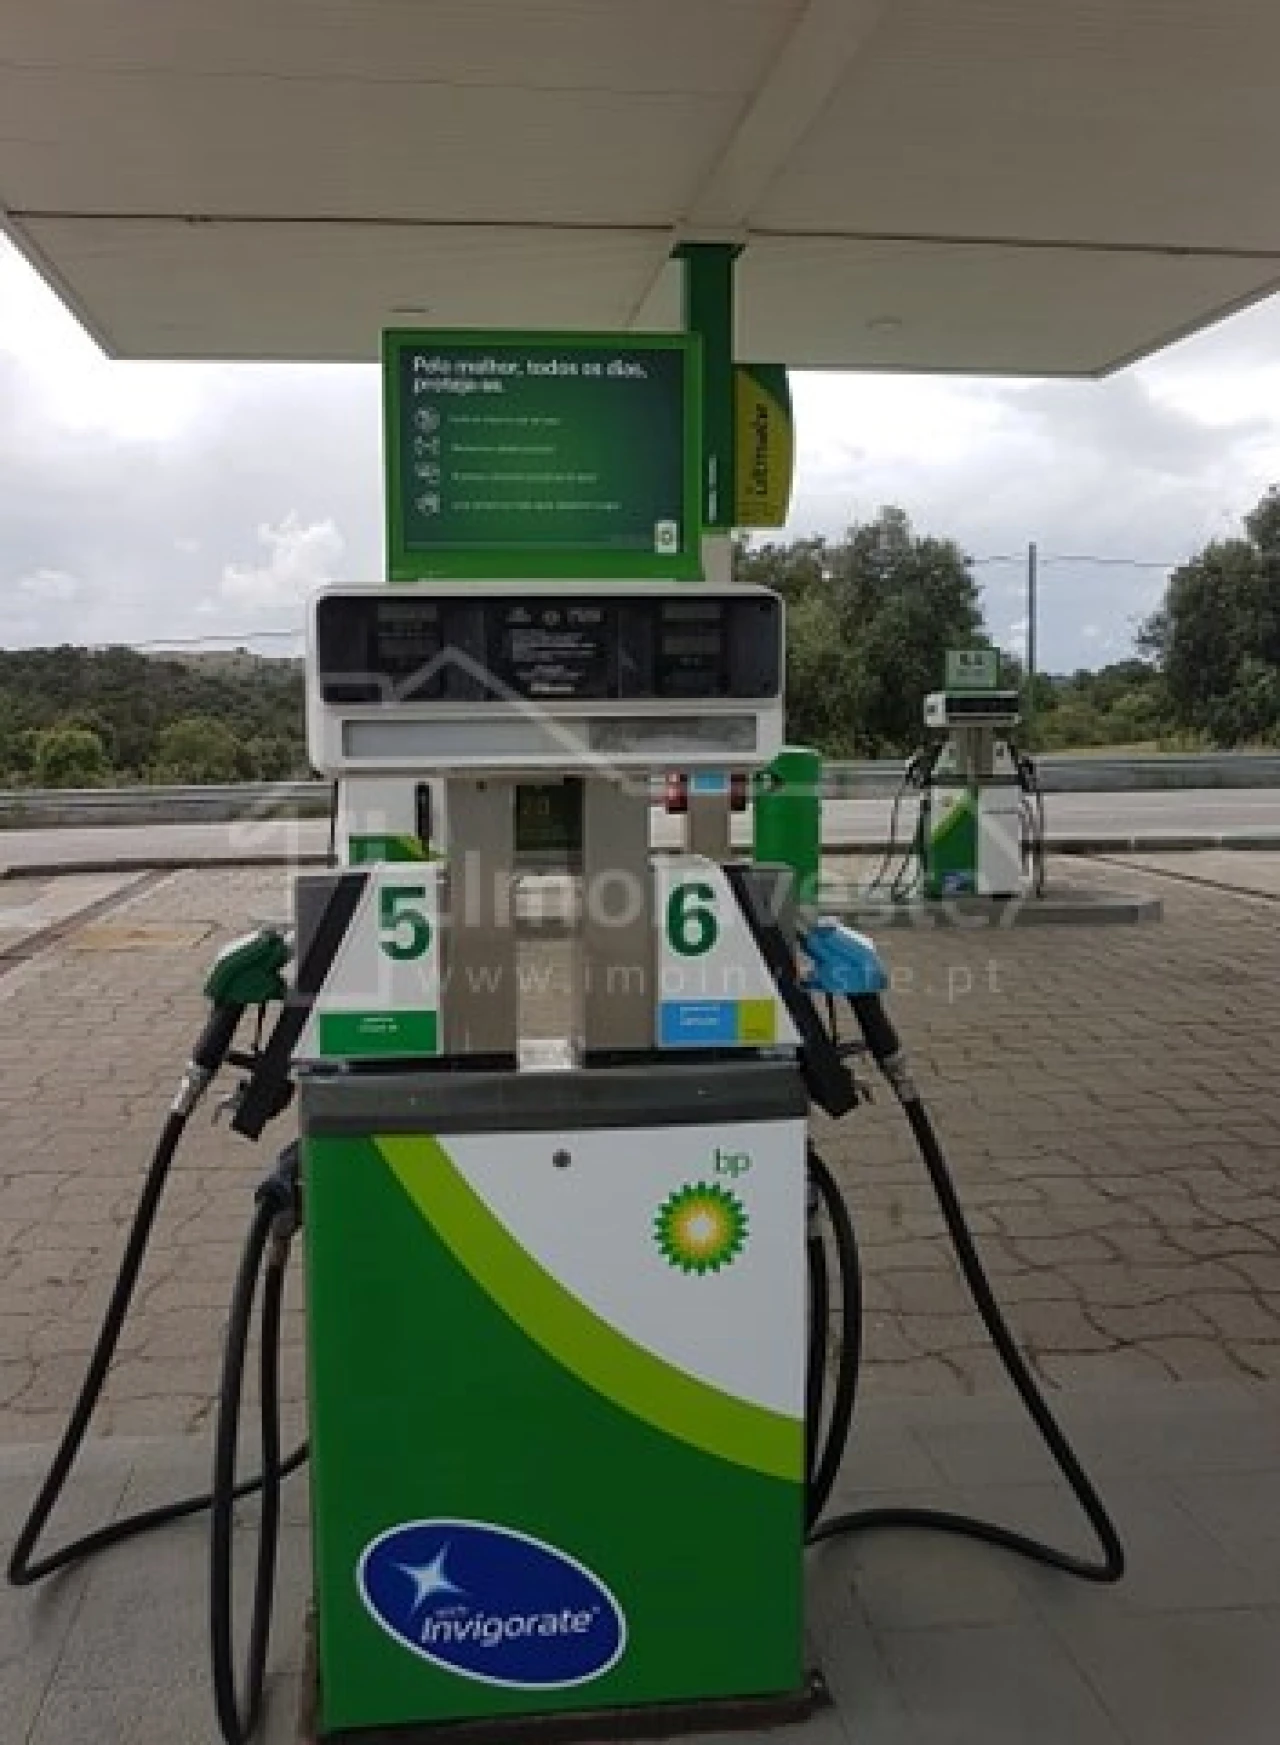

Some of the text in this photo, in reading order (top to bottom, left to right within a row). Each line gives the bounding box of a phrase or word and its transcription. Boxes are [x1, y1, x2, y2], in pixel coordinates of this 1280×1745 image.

[377, 886, 433, 962] 5
[665, 881, 718, 957] 6
[714, 1147, 753, 1178] bp
[421, 1608, 594, 1648] Invigorate
